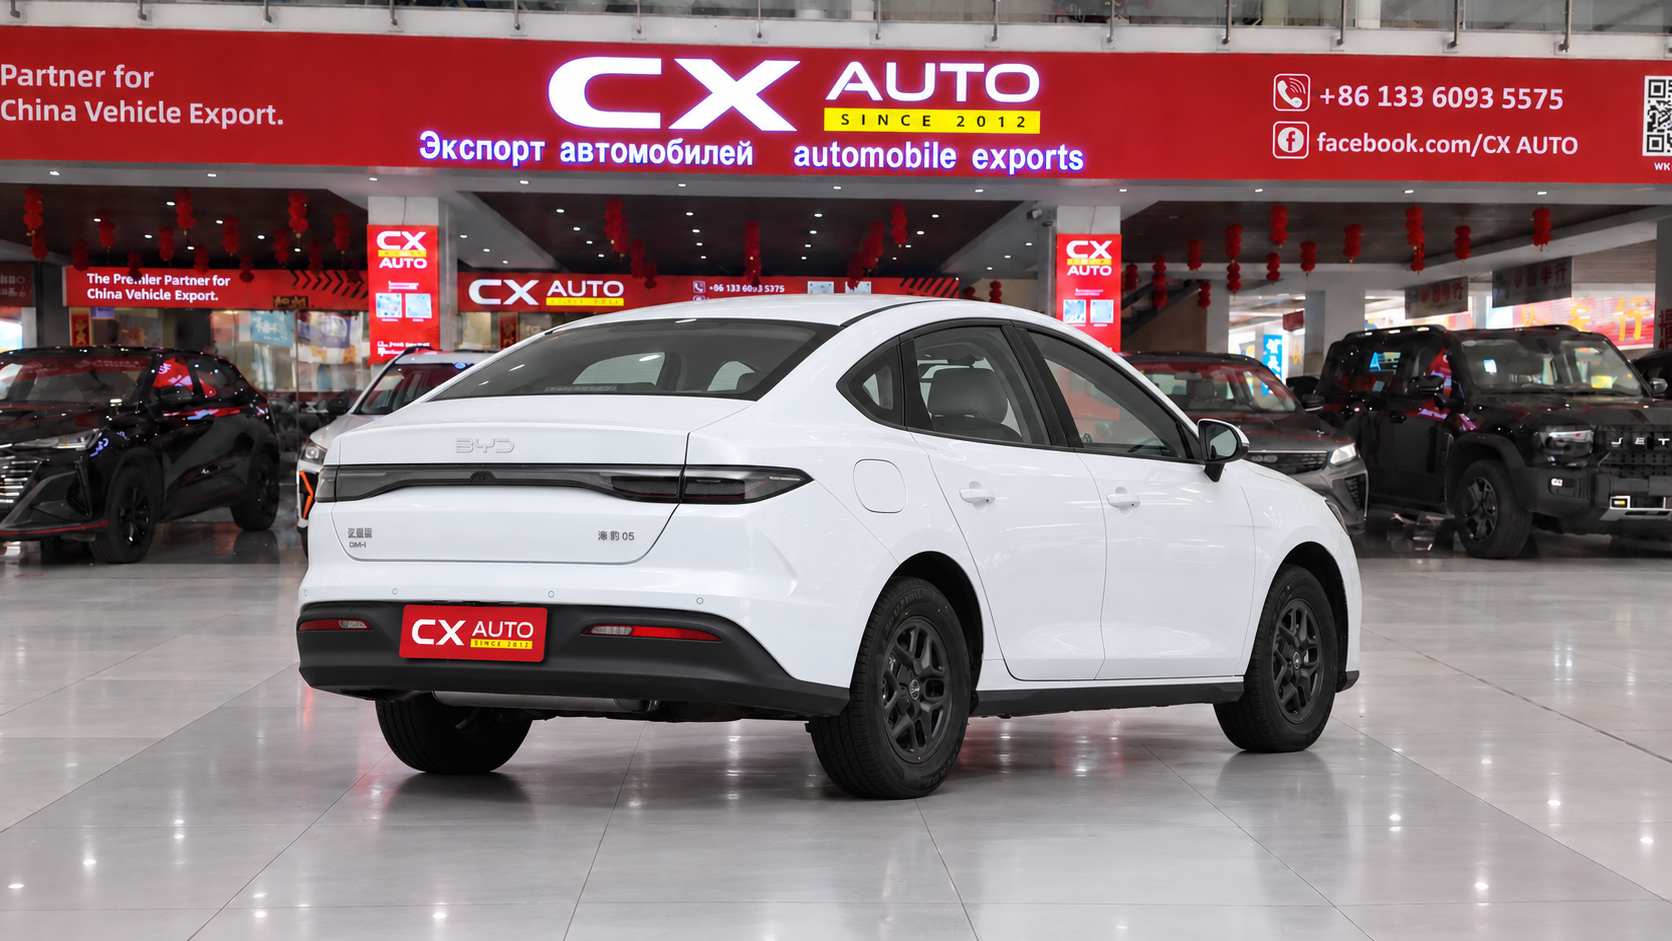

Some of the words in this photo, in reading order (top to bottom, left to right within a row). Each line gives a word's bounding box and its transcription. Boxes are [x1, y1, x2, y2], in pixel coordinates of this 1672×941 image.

[1, 64, 105, 87] Partner
[114, 64, 154, 88] for
[548, 56, 801, 132] CX
[826, 62, 1039, 102] AUTO
[1320, 85, 1369, 106] +86
[1378, 86, 1423, 107] 133
[1433, 87, 1493, 108] 6093
[1502, 88, 1563, 109] 5575
[1, 98, 76, 121] China
[85, 100, 181, 123] Vehicle
[190, 103, 283, 129] Export.
[842, 114, 930, 126] SINCE
[957, 116, 1024, 127] 2012
[419, 131, 545, 167] Экспорт
[560, 138, 753, 166] автомобилей
[1317, 132, 1510, 157] facebook.com/CX
[1516, 137, 1578, 154] AUTO
[794, 141, 956, 168] automobile
[972, 144, 1083, 175] exports
[376, 230, 426, 250] CX
[1066, 240, 1113, 259] CX
[378, 257, 428, 269] AUTO
[1066, 265, 1113, 276] AUTO
[86, 272, 111, 284] The
[164, 274, 211, 286] Partner
[212, 274, 231, 287] for
[86, 287, 123, 300] China
[126, 288, 171, 300] Vehicle
[175, 290, 218, 303] Export.
[469, 279, 539, 305] CX
[546, 279, 625, 298] AUTO
[455, 437, 515, 454] BYD
[621, 531, 635, 541] 05
[412, 619, 465, 645] CX
[471, 620, 534, 638] AUTO
